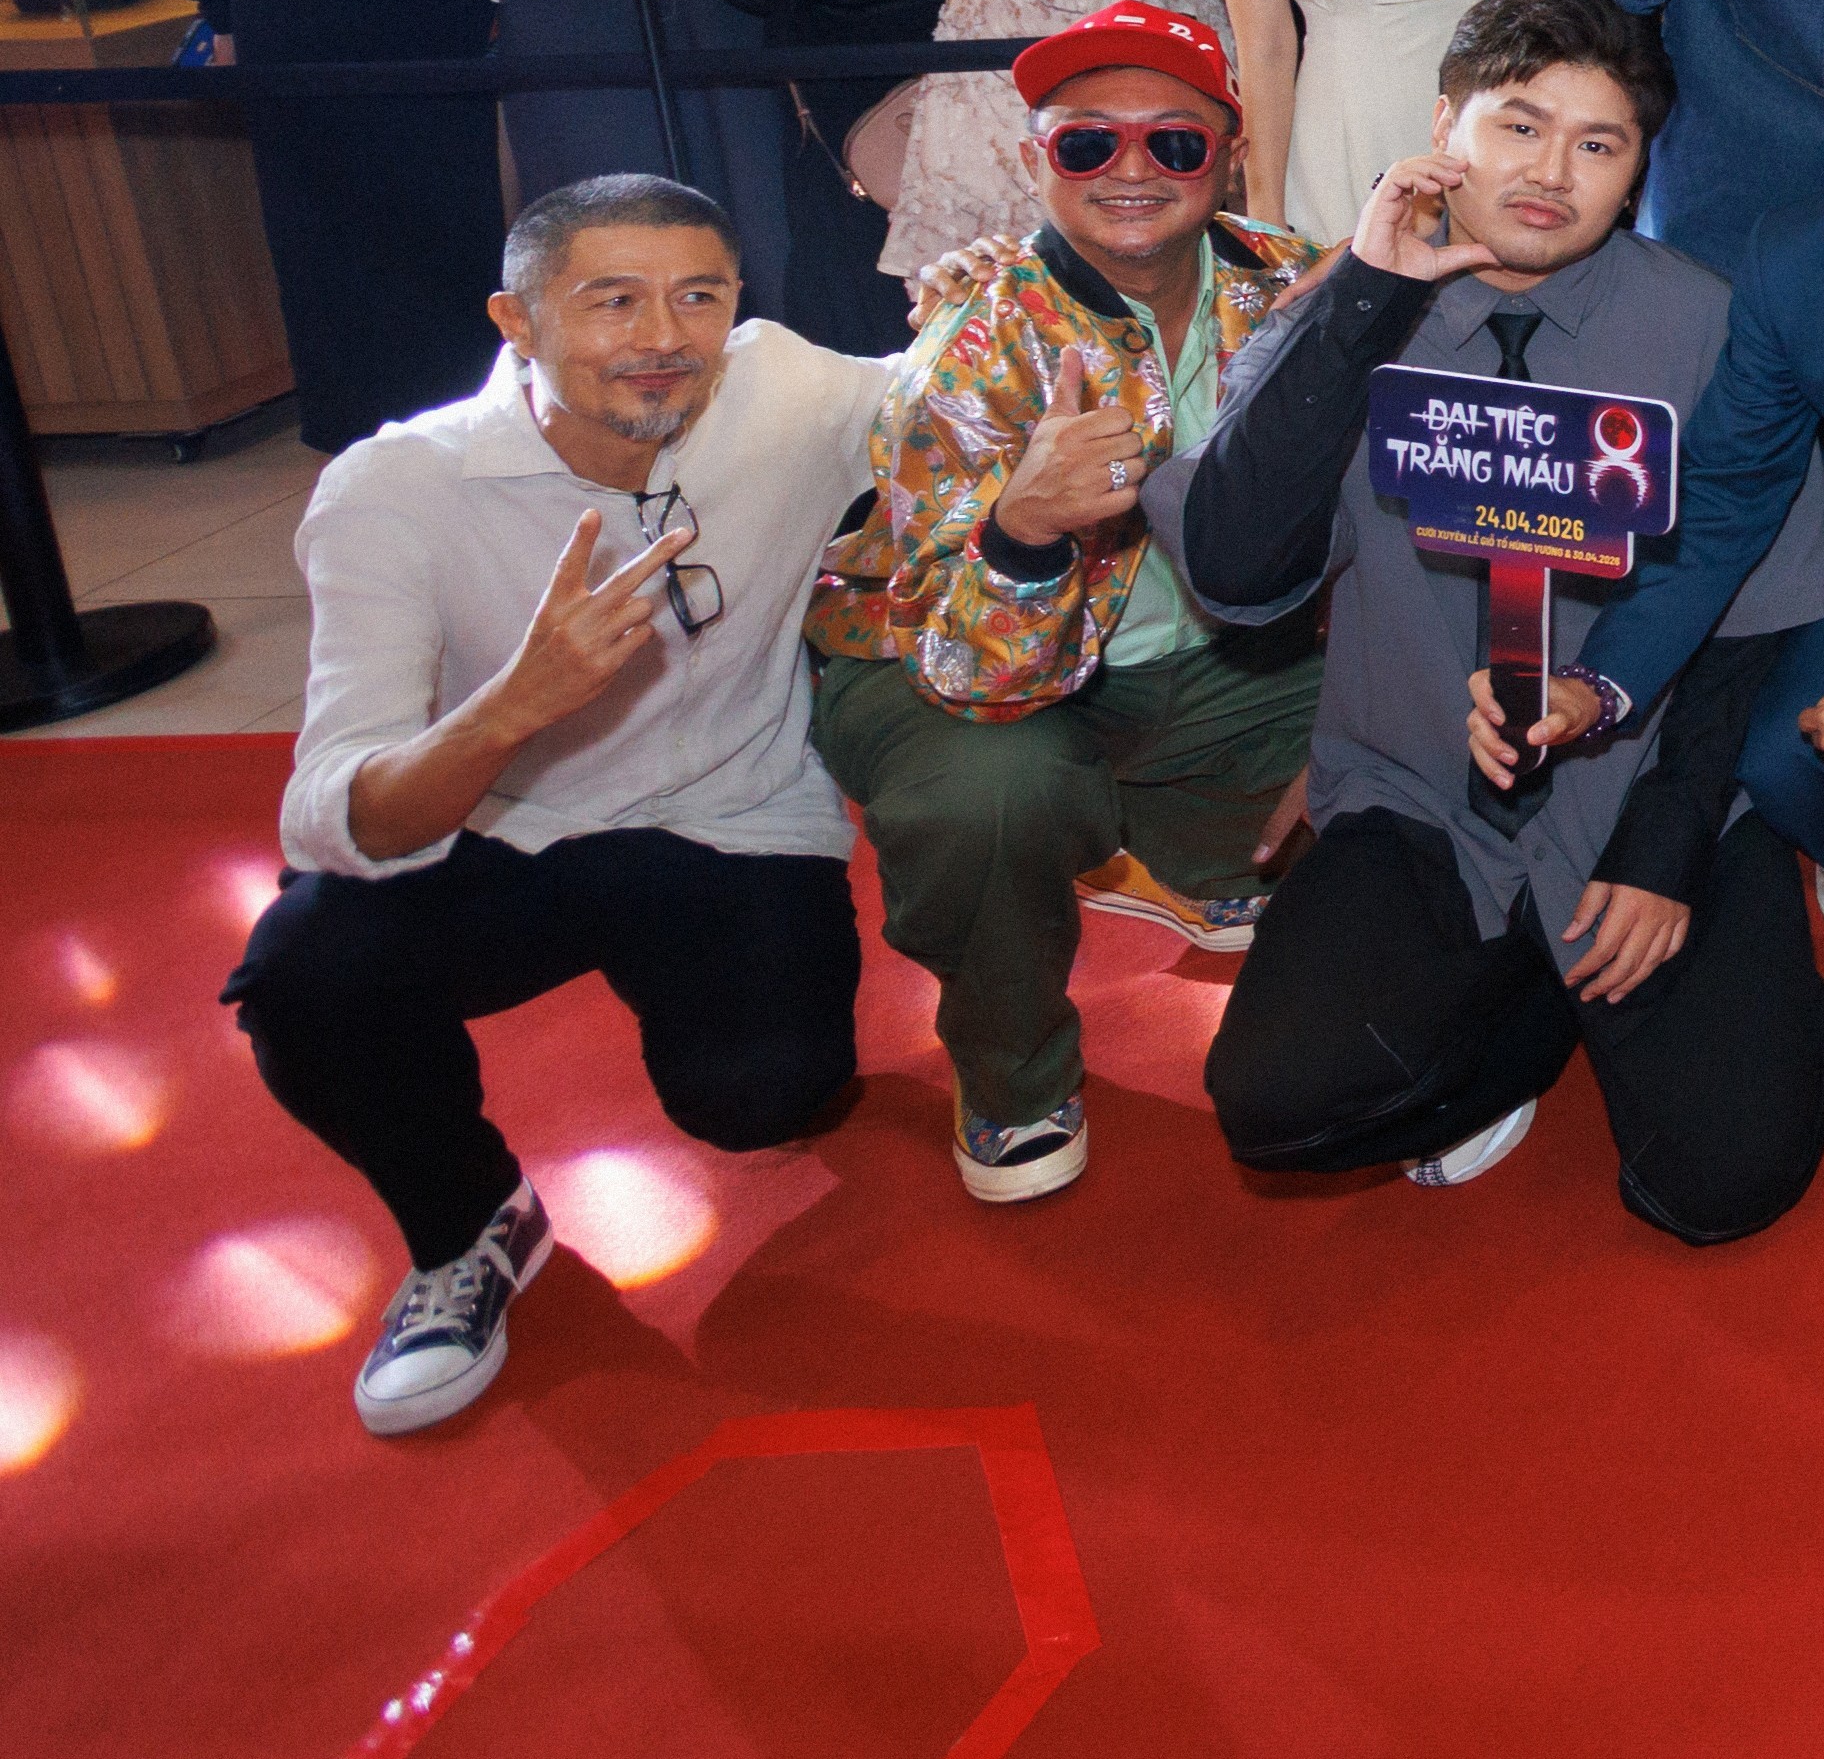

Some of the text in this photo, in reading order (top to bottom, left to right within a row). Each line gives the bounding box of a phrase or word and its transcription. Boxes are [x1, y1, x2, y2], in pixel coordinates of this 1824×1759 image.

[1422, 399, 1556, 449] ĐẠI TIỆC
[1387, 433, 1492, 483] TRĂNG
[1503, 452, 1574, 494] MÁU
[1475, 505, 1585, 541] 24.04.2026
